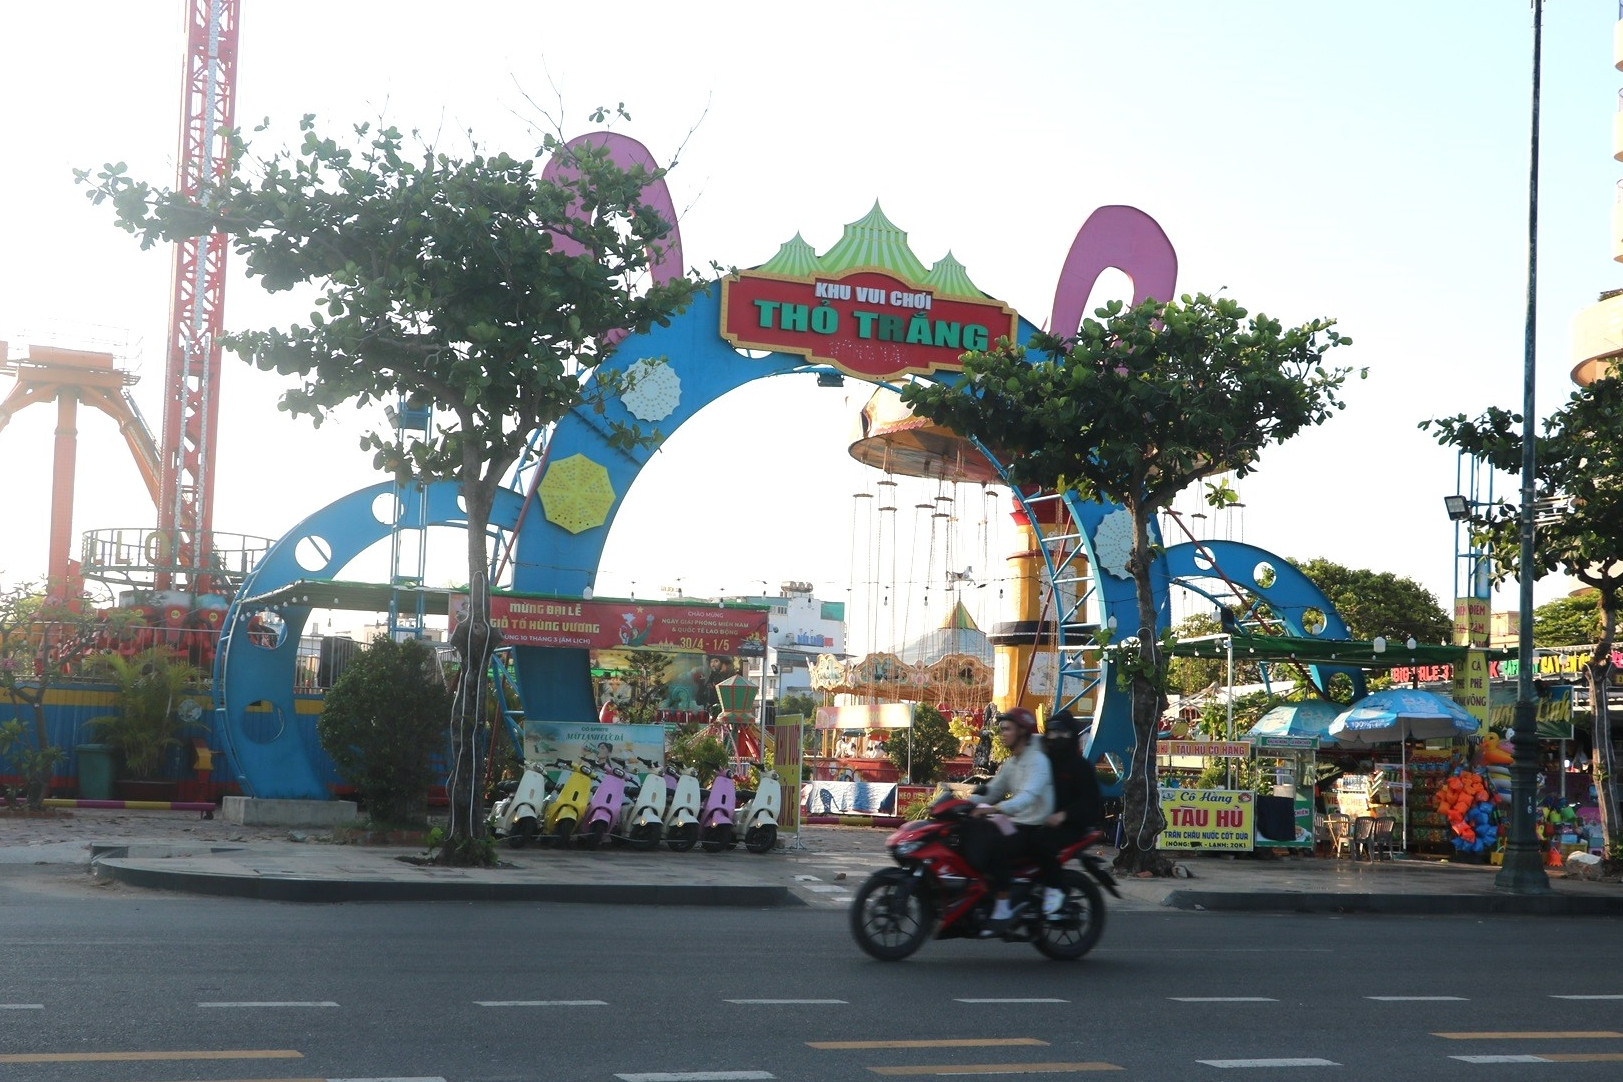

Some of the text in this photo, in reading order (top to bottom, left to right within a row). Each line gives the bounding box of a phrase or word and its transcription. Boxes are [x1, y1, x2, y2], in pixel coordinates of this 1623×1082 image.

[815, 281, 932, 311] KHU VUI CHƠI
[753, 298, 989, 352] THỎ TRẮNG
[509, 602, 545, 615] MỪNG
[529, 619, 559, 632] HÙNG
[562, 622, 600, 634] VƯƠNG
[680, 637, 704, 650] 30/4
[713, 638, 730, 651] 1/5
[1181, 791, 1196, 801] Cô
[1216, 805, 1244, 828] HỦ
[1164, 831, 1249, 841] TRÂN CHÂU NƯỚC CỐT DỪA
